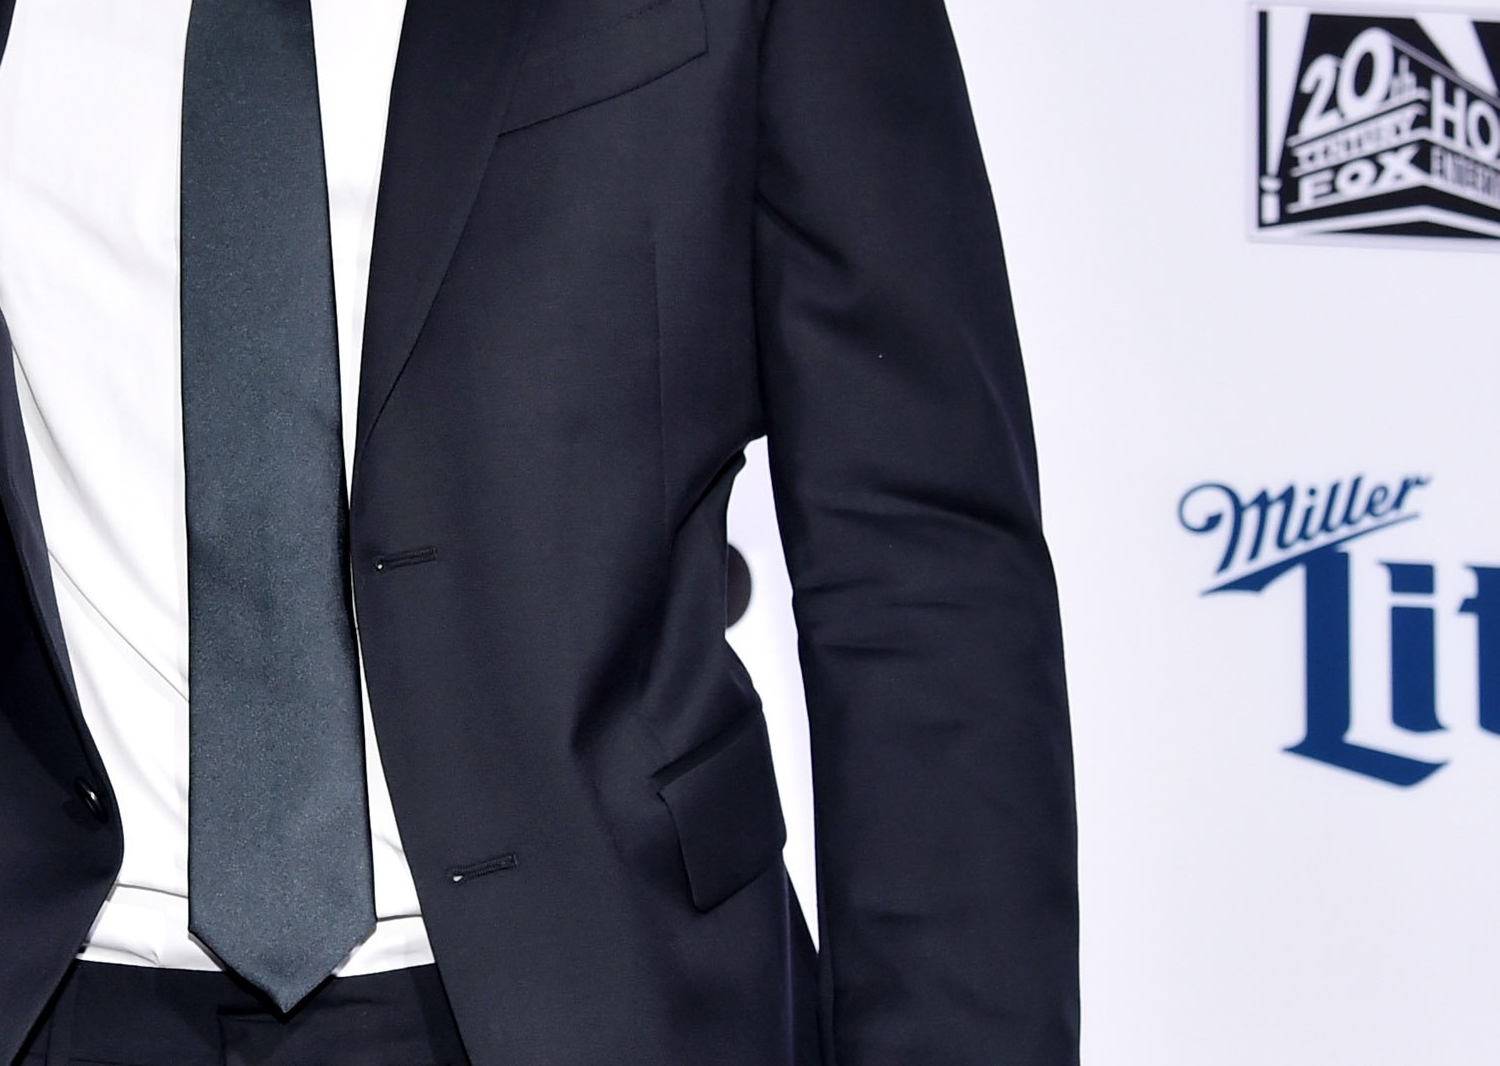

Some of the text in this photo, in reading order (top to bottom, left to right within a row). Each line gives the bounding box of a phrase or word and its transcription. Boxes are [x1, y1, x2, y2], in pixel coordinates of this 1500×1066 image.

[1299, 27, 1419, 137] 20th
[1296, 143, 1430, 209] FOX
[1178, 474, 1434, 576] Miller
[1280, 548, 1500, 788] Lit
